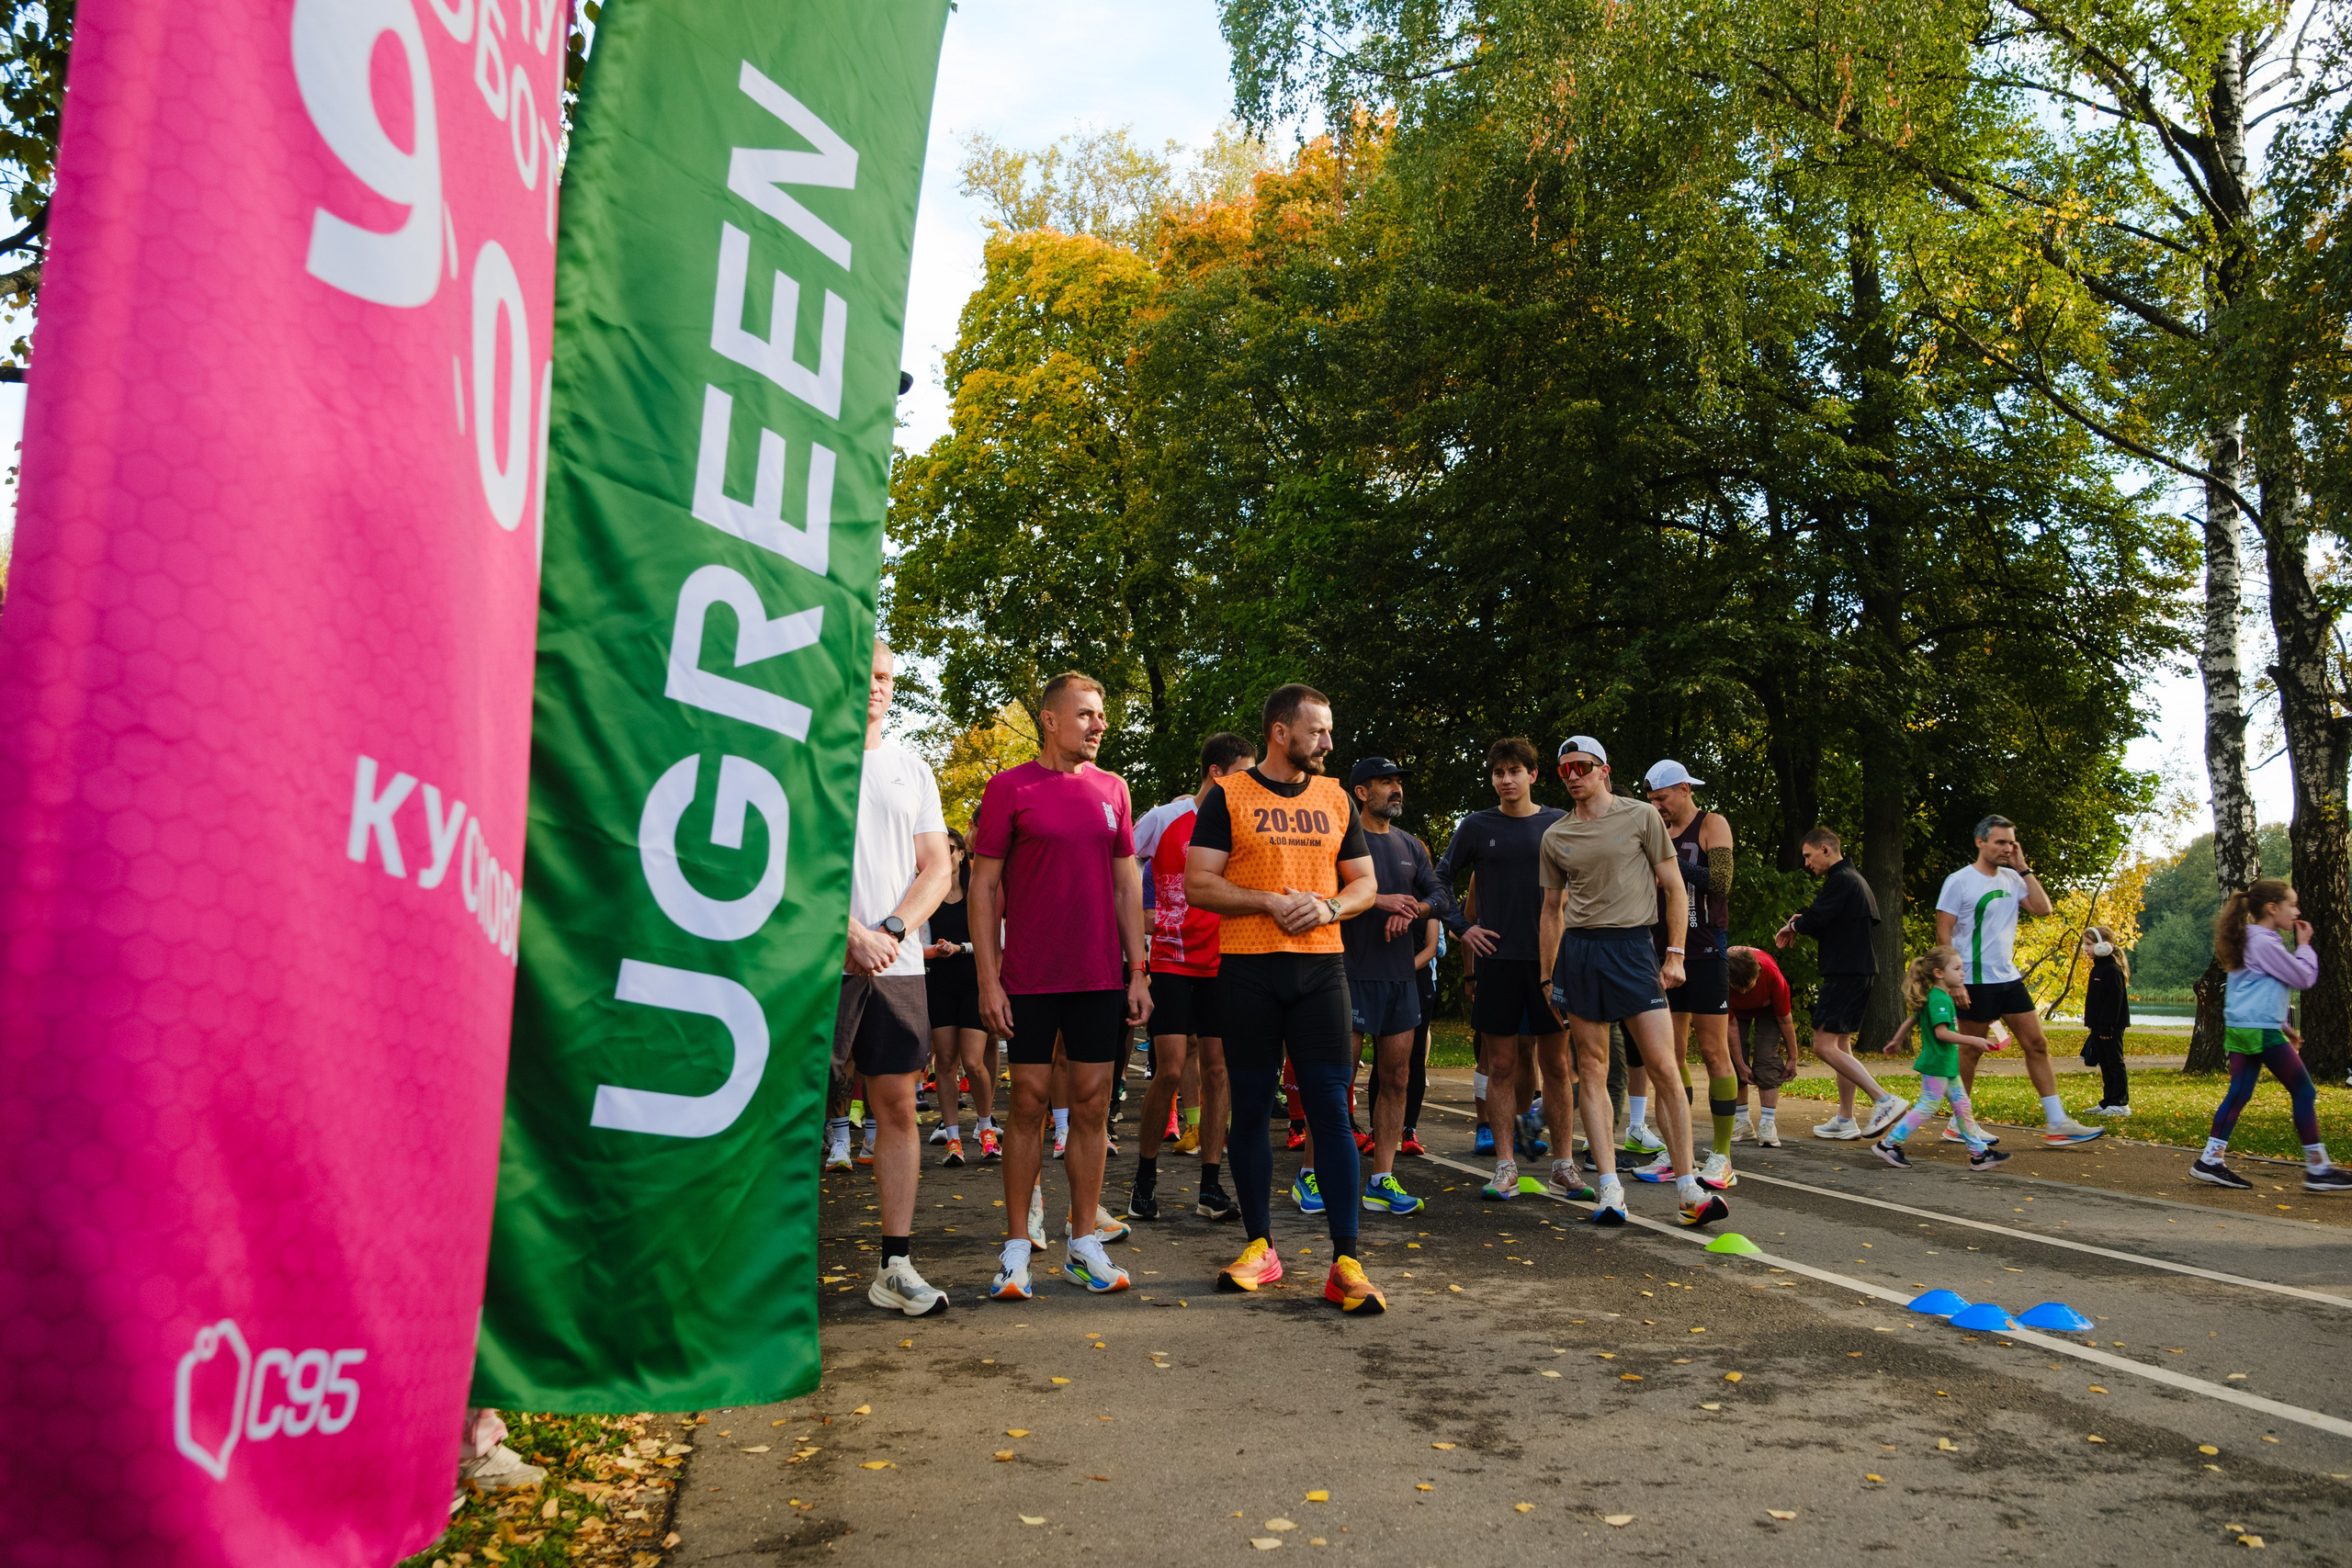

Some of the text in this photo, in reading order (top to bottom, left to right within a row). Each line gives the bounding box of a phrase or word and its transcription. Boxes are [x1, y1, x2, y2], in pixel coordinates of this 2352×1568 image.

[590, 59, 859, 1138] UGREEN
[1253, 807, 1330, 835] 20:00
[1269, 836, 1287, 846] 4:00
[1688, 907, 1698, 928] 1906
